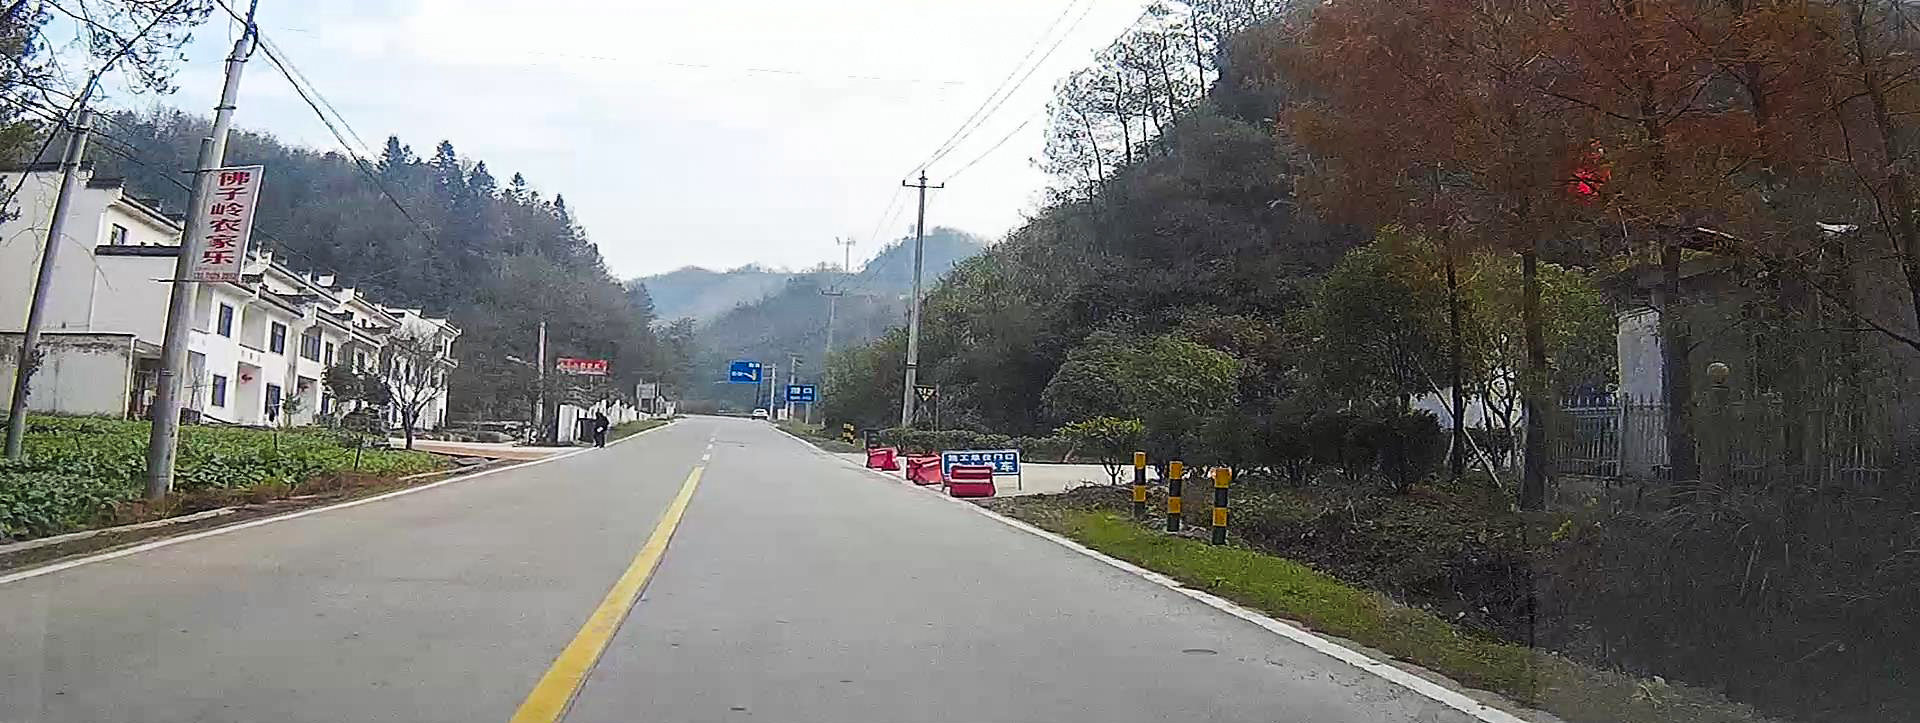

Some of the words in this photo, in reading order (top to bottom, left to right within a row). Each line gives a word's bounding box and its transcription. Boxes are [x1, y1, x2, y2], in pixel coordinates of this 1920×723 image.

[202, 172, 250, 264] 佛子岭农家乐
